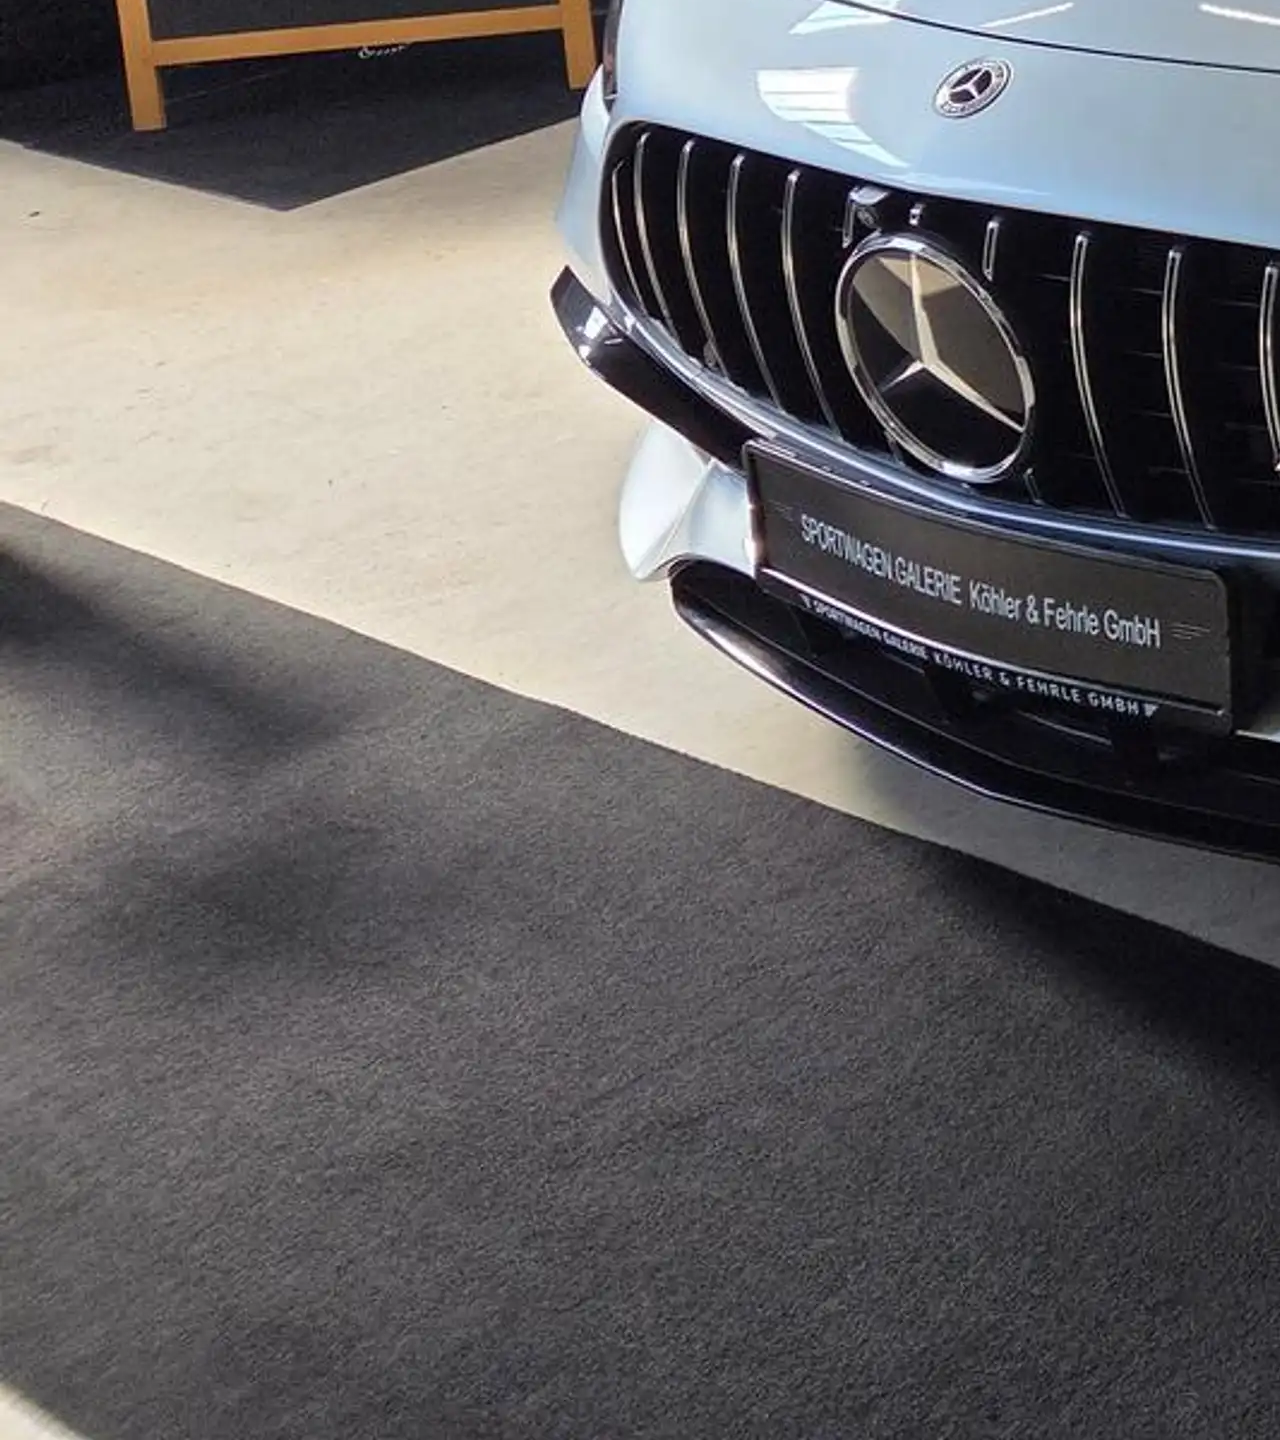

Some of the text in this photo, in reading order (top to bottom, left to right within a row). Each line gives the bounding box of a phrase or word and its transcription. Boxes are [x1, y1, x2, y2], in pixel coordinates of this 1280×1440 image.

[800, 513, 1161, 649] SPORTWAGEN GALERIE Köhler & Fehrle GmbH
[1016, 675, 1082, 704] FEHRLE
[1087, 690, 1139, 717] GMBH
